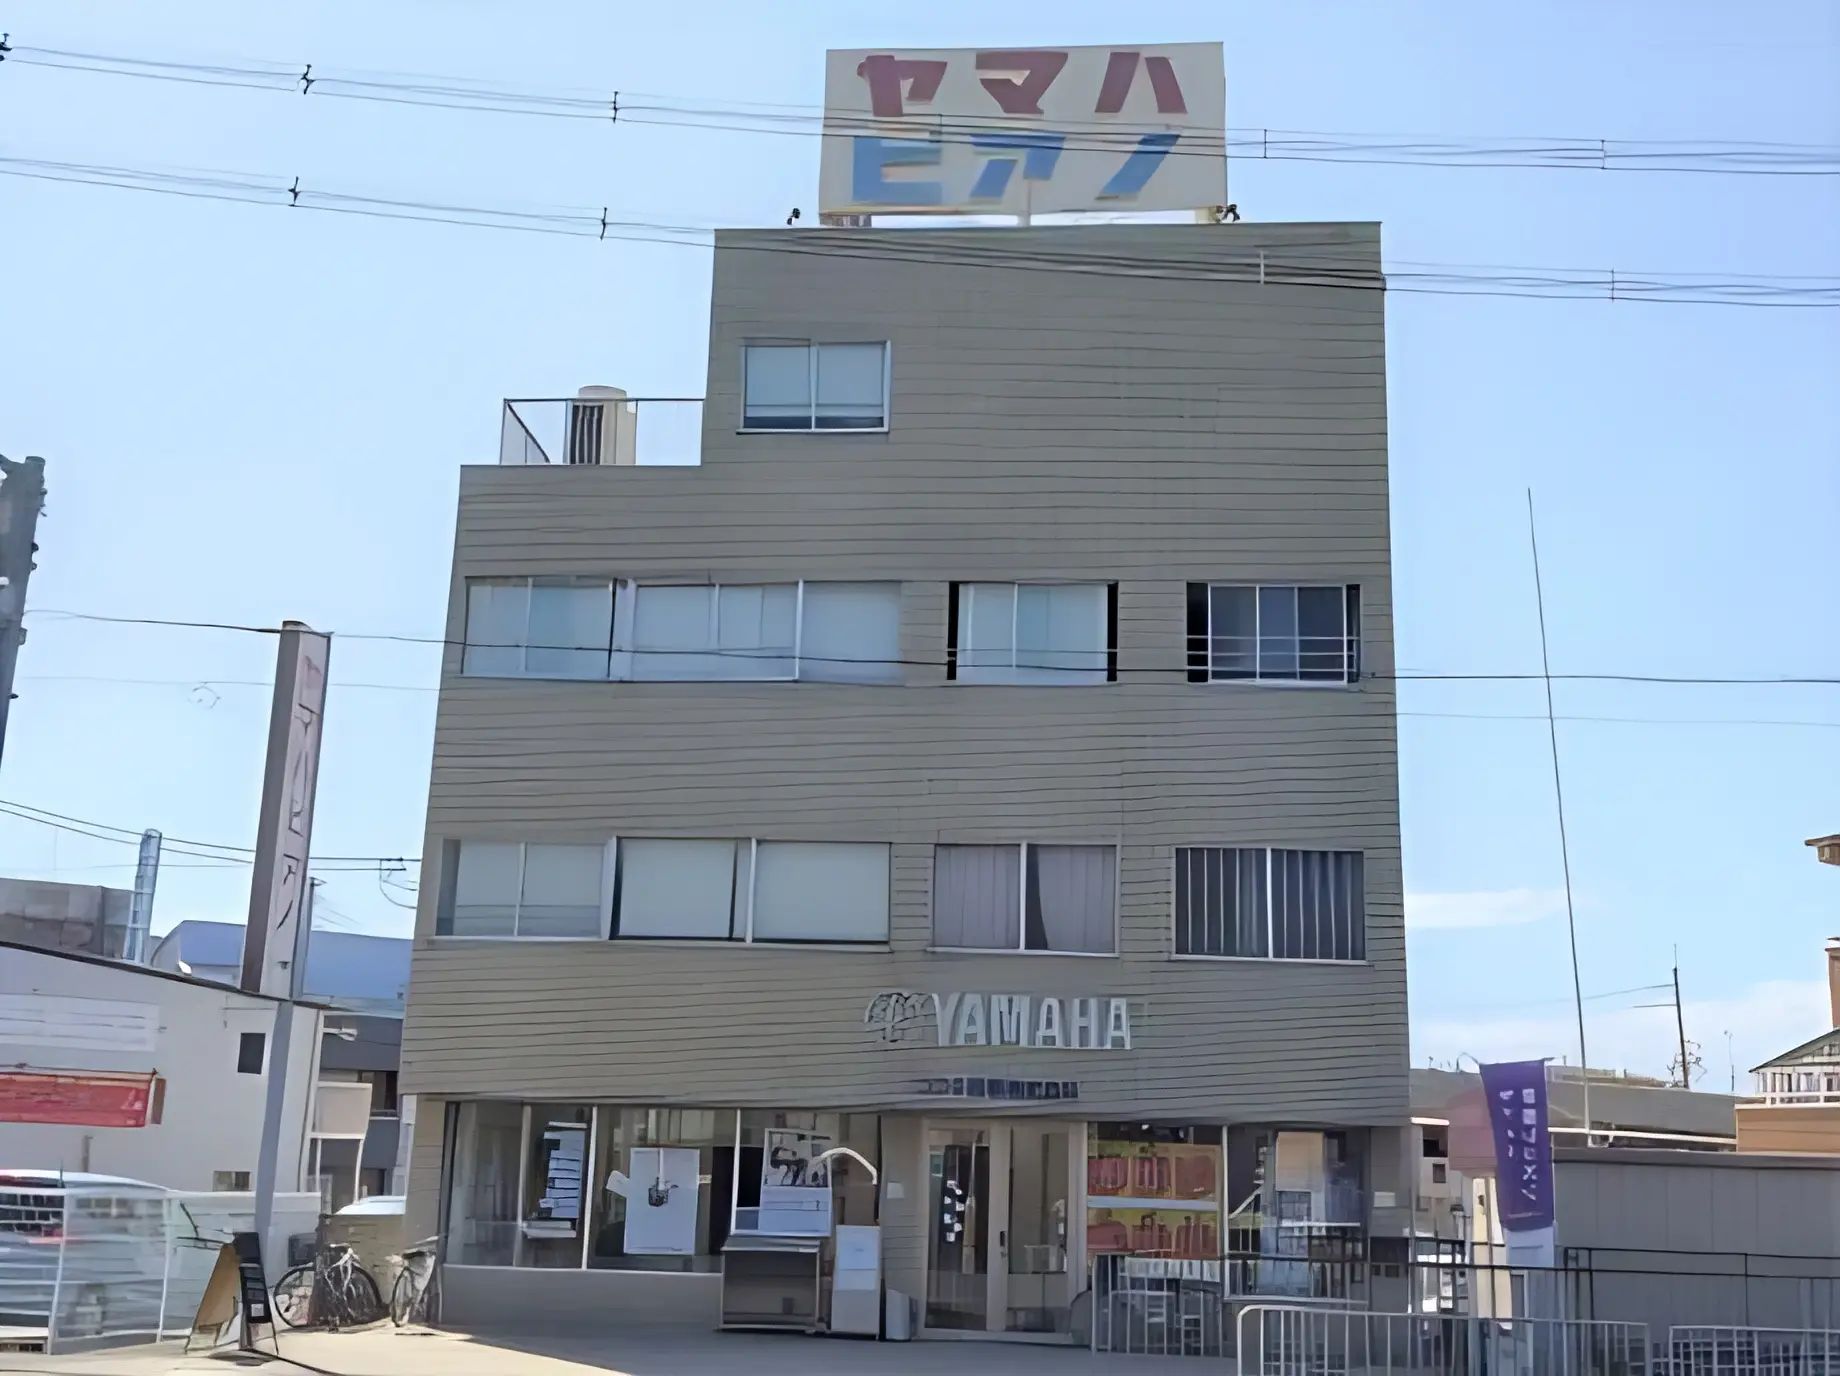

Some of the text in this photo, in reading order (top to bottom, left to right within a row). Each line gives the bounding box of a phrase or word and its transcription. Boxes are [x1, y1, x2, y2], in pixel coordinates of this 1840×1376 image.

[855, 50, 1188, 117] ヤマハ
[931, 992, 1132, 1050] YAMAHA
